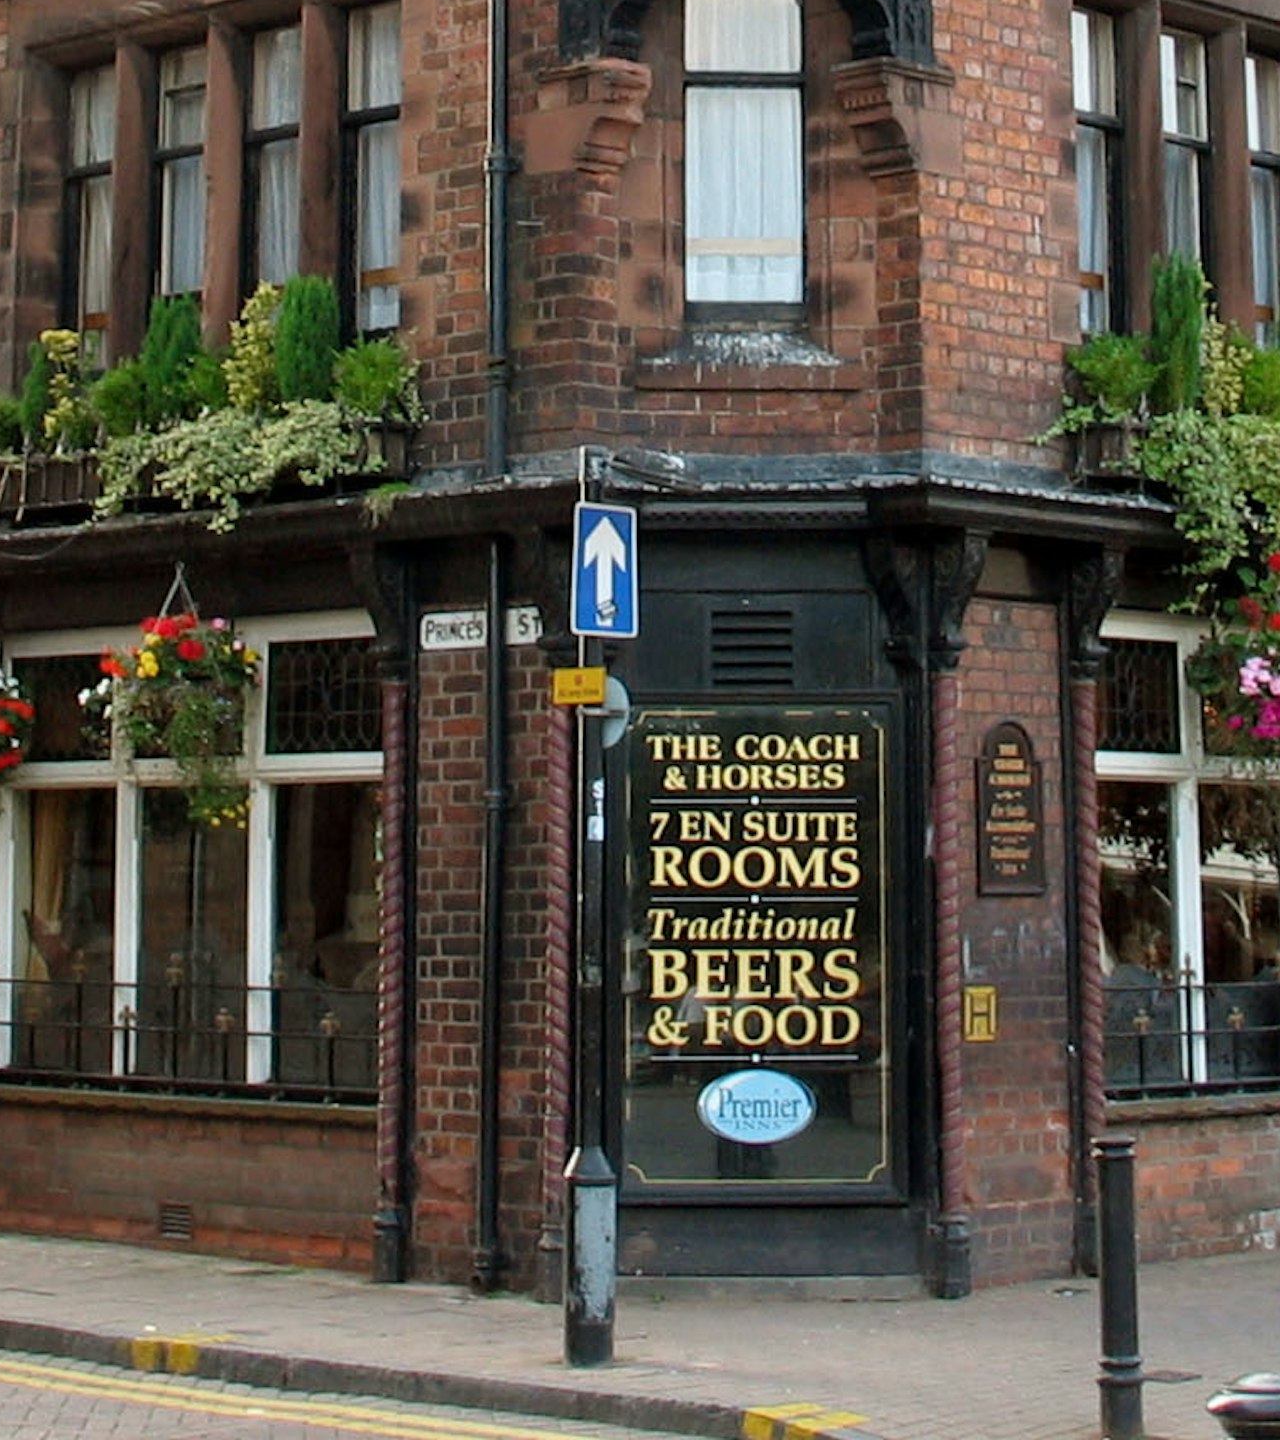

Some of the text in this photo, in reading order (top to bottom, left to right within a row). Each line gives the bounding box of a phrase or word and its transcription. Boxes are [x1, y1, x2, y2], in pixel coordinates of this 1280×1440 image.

[646, 734, 860, 760] THE COACH
[663, 764, 846, 791] & HORSES
[650, 811, 858, 842] 7 EN SUITE
[649, 846, 861, 889] ROOMS
[647, 908, 856, 941] Traditional
[647, 948, 861, 1000] BEERS
[647, 1004, 862, 1047] & FOOD
[719, 1087, 803, 1119] Premier
[734, 1120, 783, 1130] INNS
